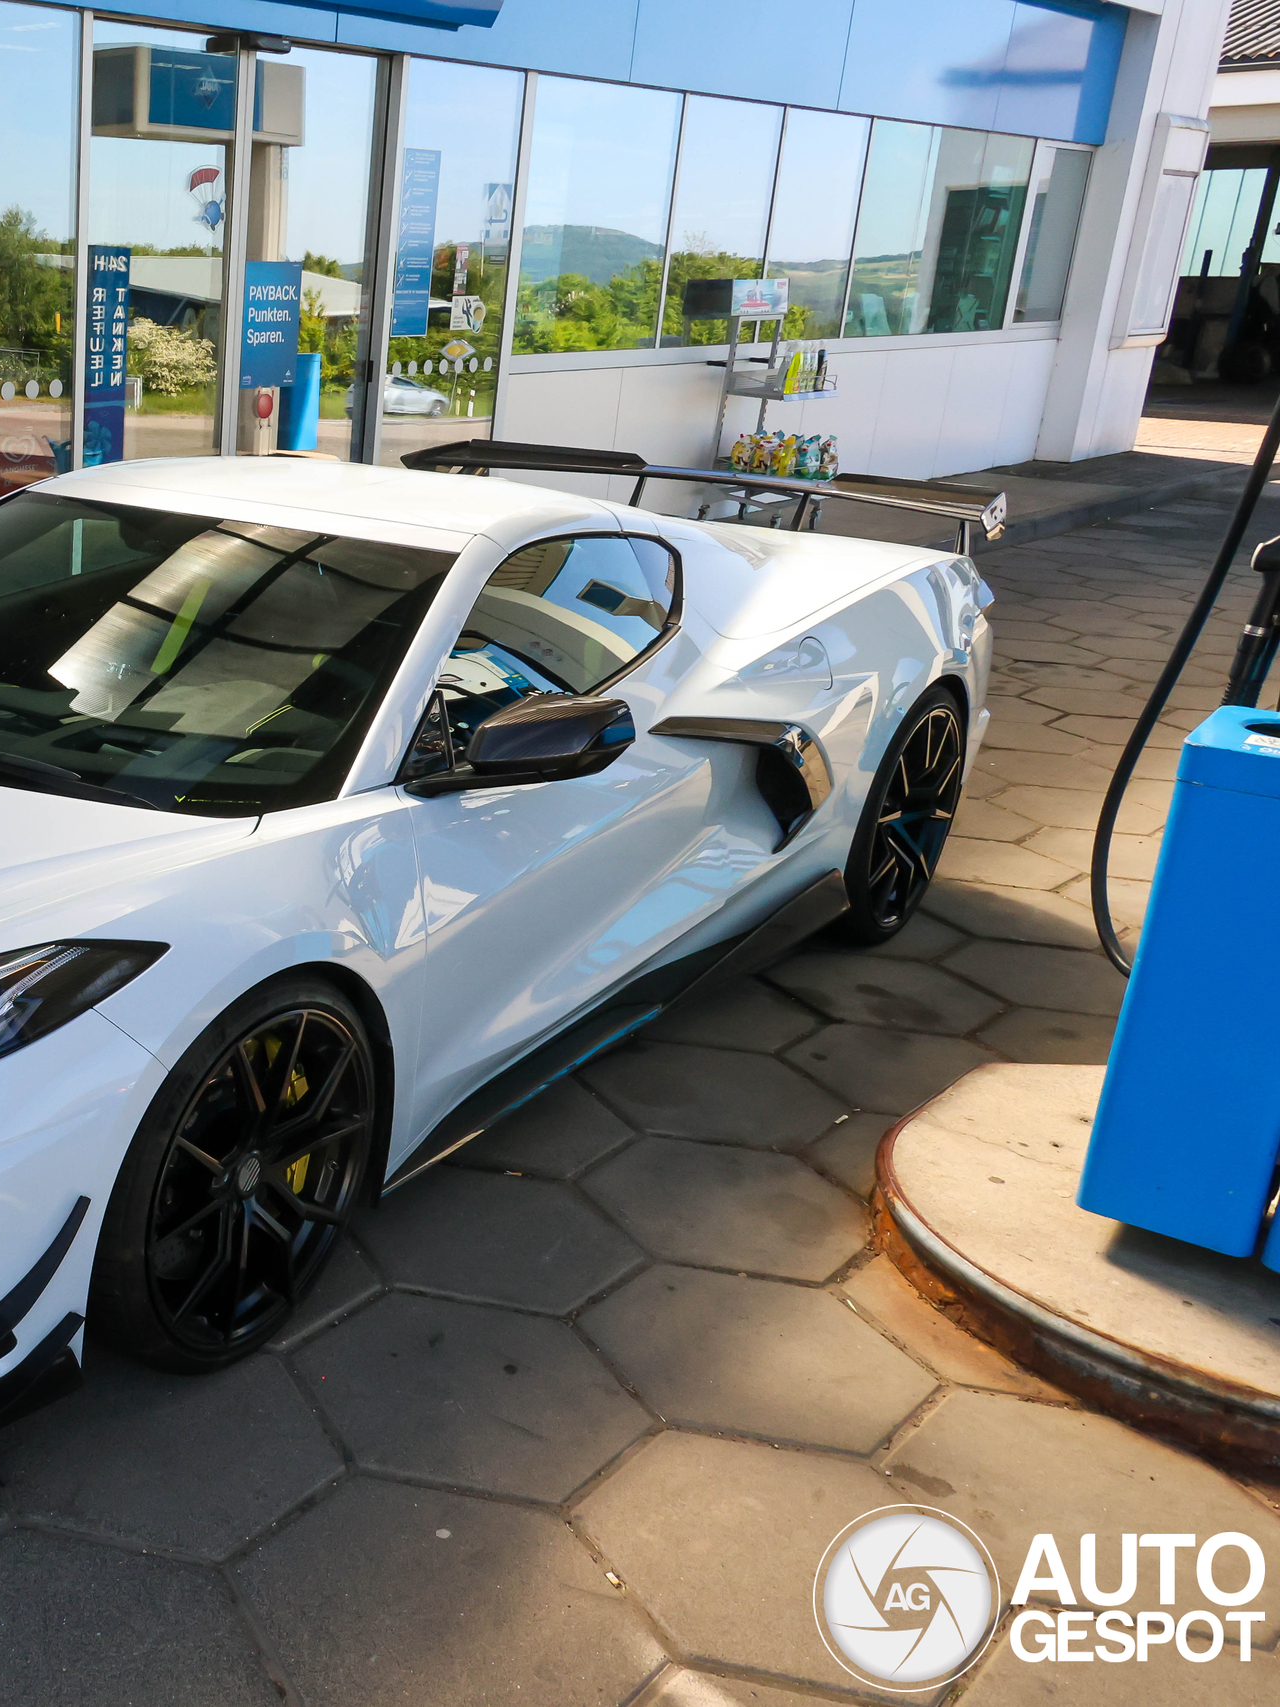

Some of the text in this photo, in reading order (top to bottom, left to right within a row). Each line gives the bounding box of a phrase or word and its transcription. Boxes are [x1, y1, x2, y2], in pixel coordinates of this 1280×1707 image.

[249, 285, 298, 301] PAYBACK.
[248, 307, 292, 322] Punkten.
[246, 329, 285, 346] Sparen.
